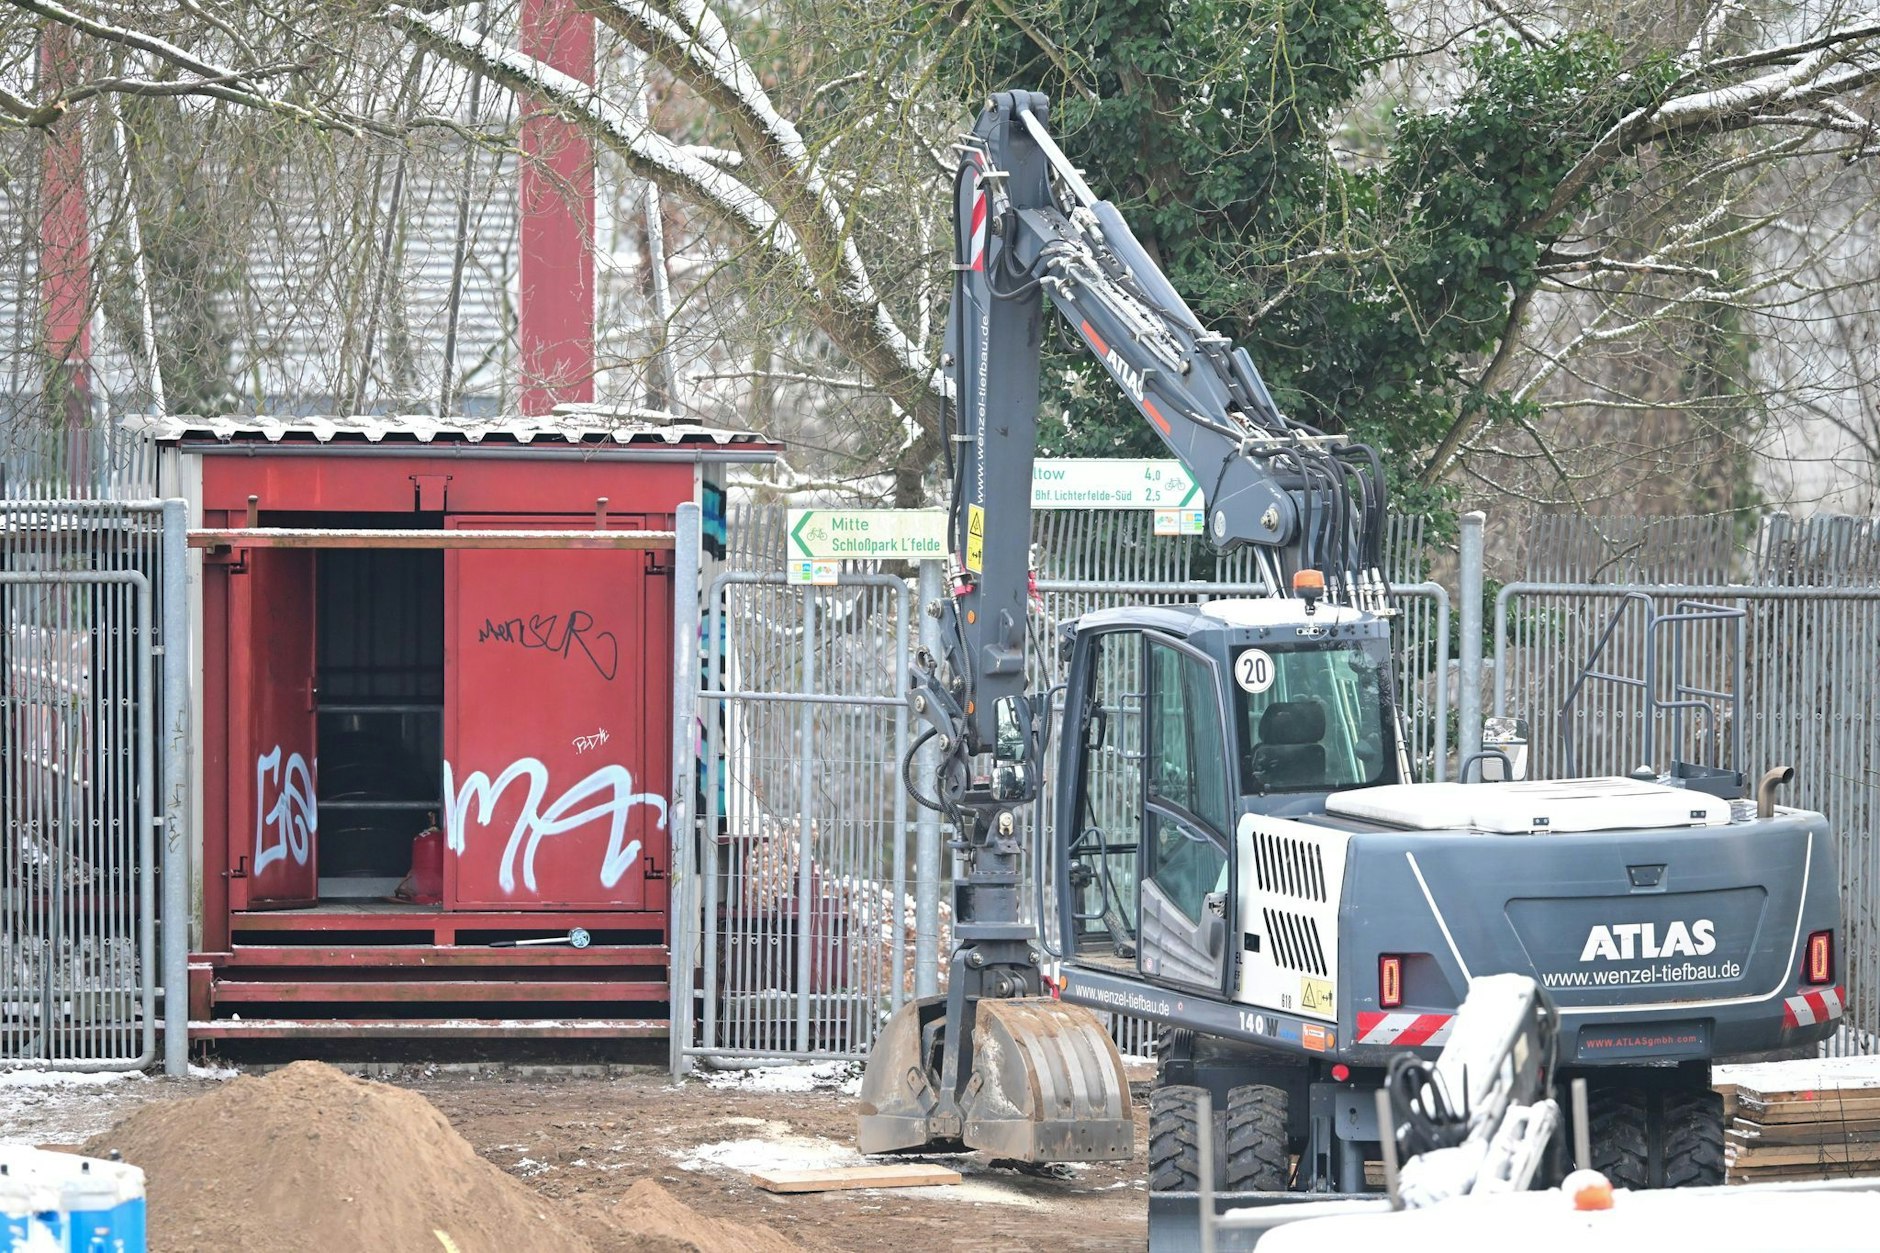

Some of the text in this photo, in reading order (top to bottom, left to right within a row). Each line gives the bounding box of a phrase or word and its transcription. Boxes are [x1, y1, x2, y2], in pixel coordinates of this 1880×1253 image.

[978, 314, 990, 504] www.wenzel-tiefbau.de
[1035, 489, 1052, 501] Bhf.
[1054, 489, 1132, 501] Lichterfelde-Süd
[832, 517, 869, 531] Mitte
[832, 537, 898, 555] Schloßpark
[1243, 657, 1267, 685] 20
[1580, 918, 1717, 962] ATLAS
[1542, 960, 1741, 987] www.wenzel-tiefbau.de
[1075, 984, 1170, 1017] www.wenzel-tiefbau.de
[1239, 1011, 1264, 1035] 140
[1266, 1016, 1279, 1038] W
